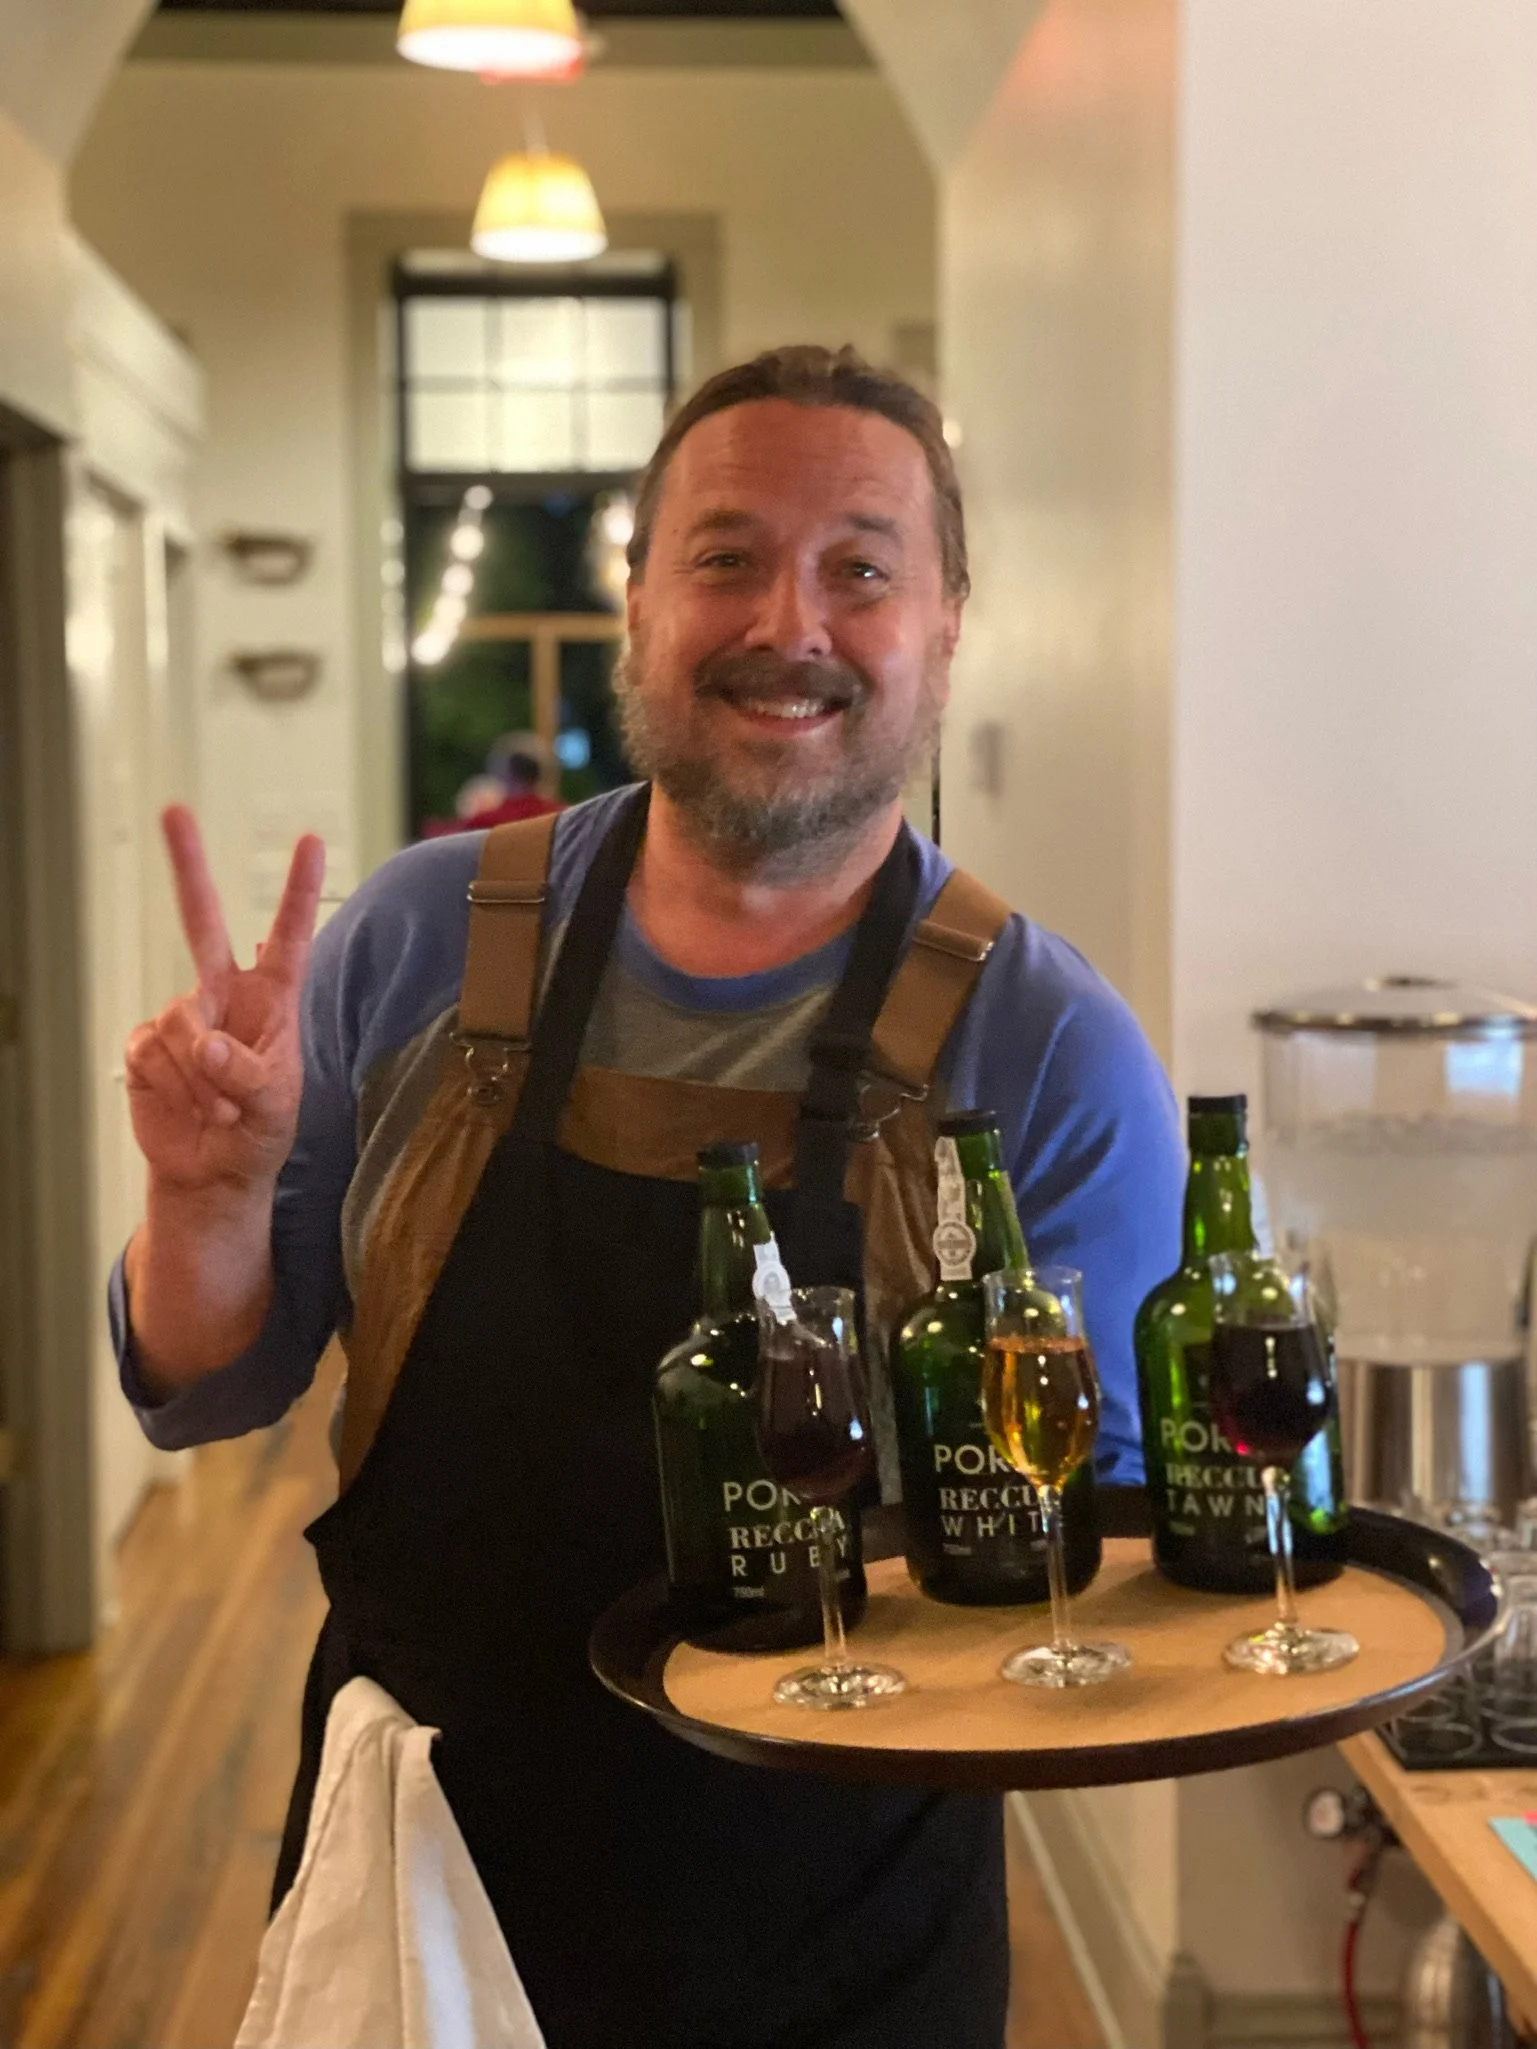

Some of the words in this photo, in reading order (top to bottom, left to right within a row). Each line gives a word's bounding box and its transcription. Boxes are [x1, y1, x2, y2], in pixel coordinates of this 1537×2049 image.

[1160, 1418, 1232, 1453] POR
[933, 1444, 1011, 1475] POR
[1165, 1489, 1266, 1517] TAWN
[941, 1511, 1040, 1538] WHIT
